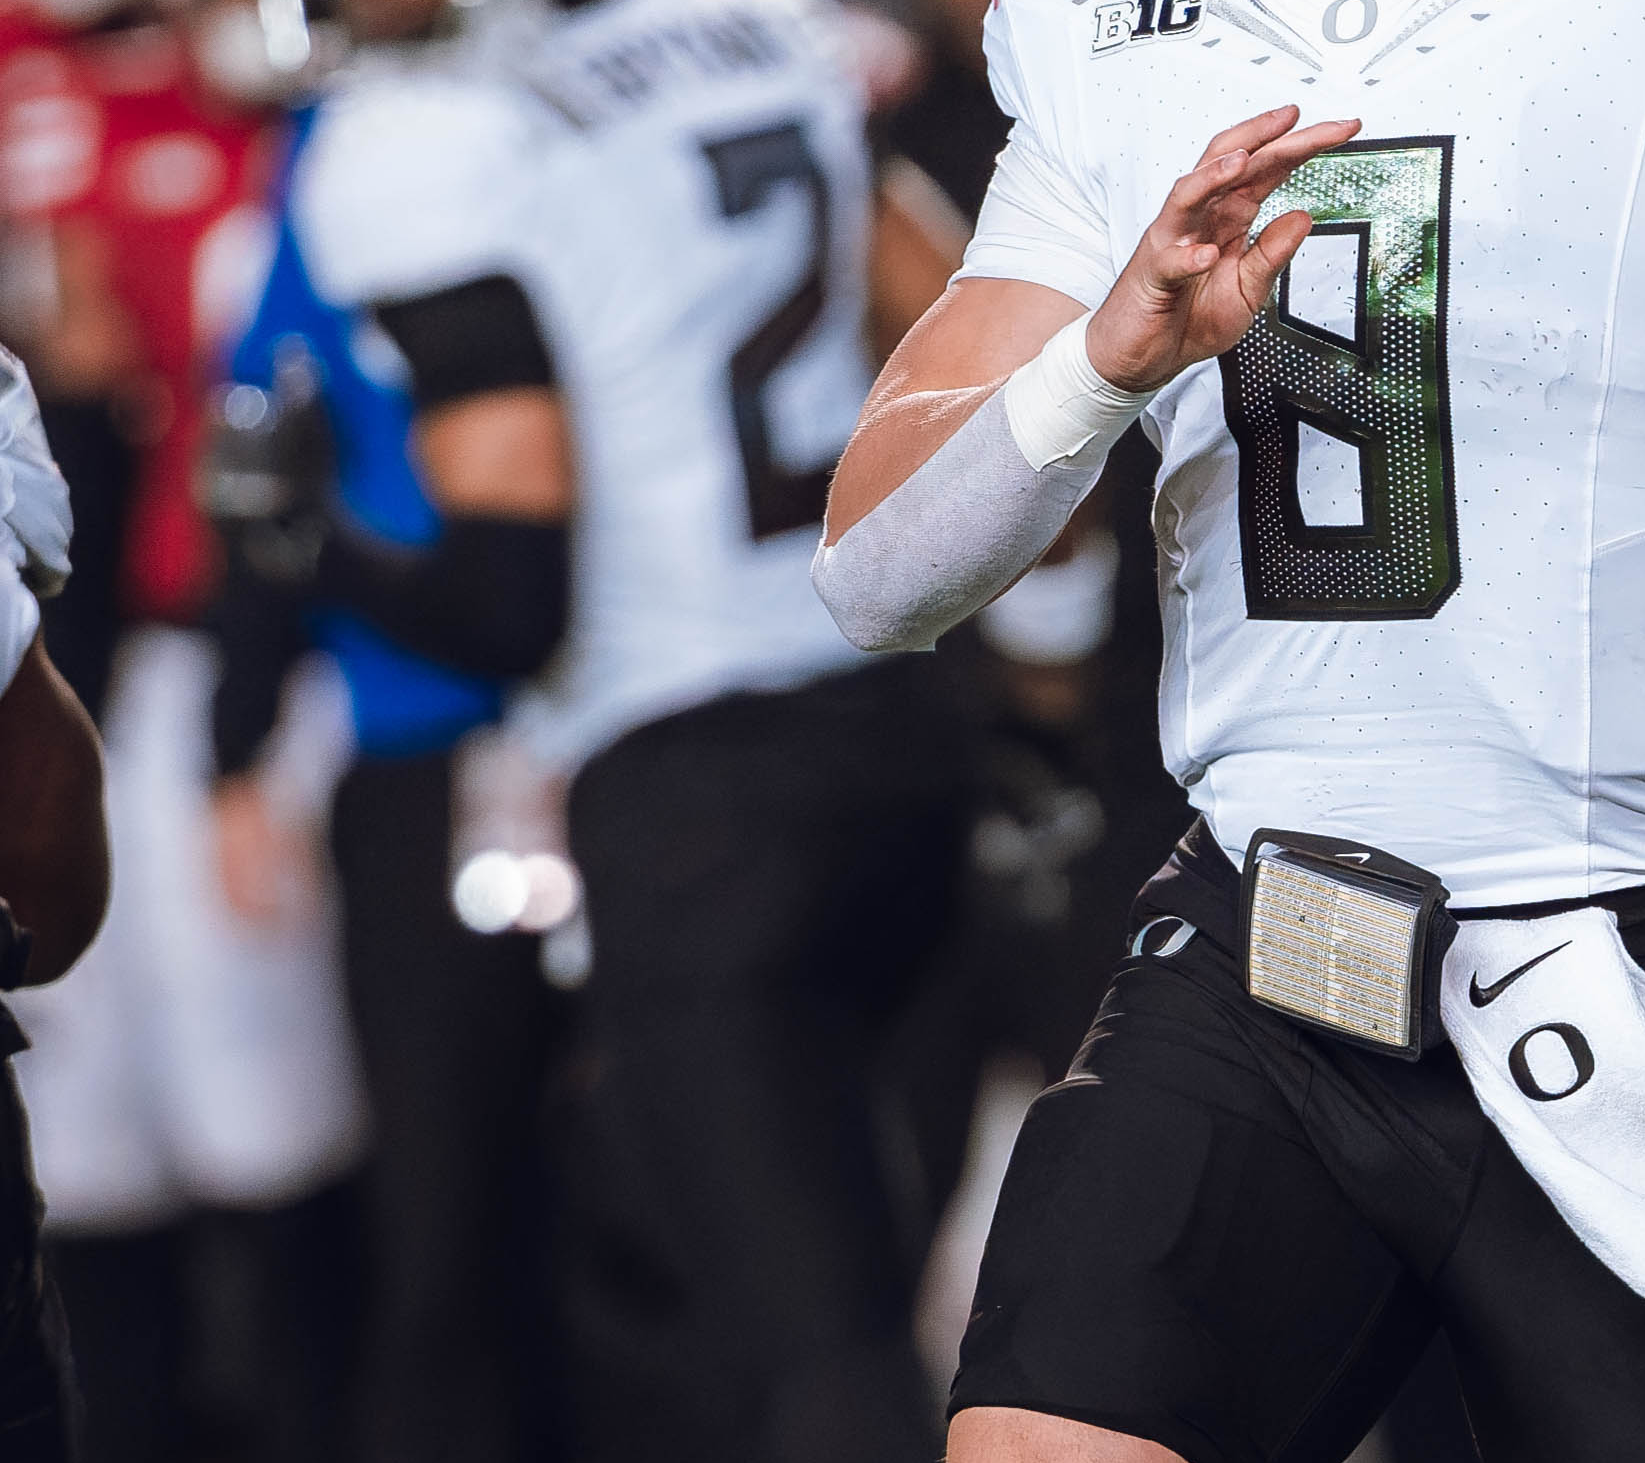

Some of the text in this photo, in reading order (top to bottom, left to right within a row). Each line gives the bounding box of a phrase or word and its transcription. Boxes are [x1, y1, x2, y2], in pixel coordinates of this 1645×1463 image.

[701, 122, 836, 540] 2
[1216, 134, 1463, 621] 8
[1507, 1021, 1596, 1103] O
